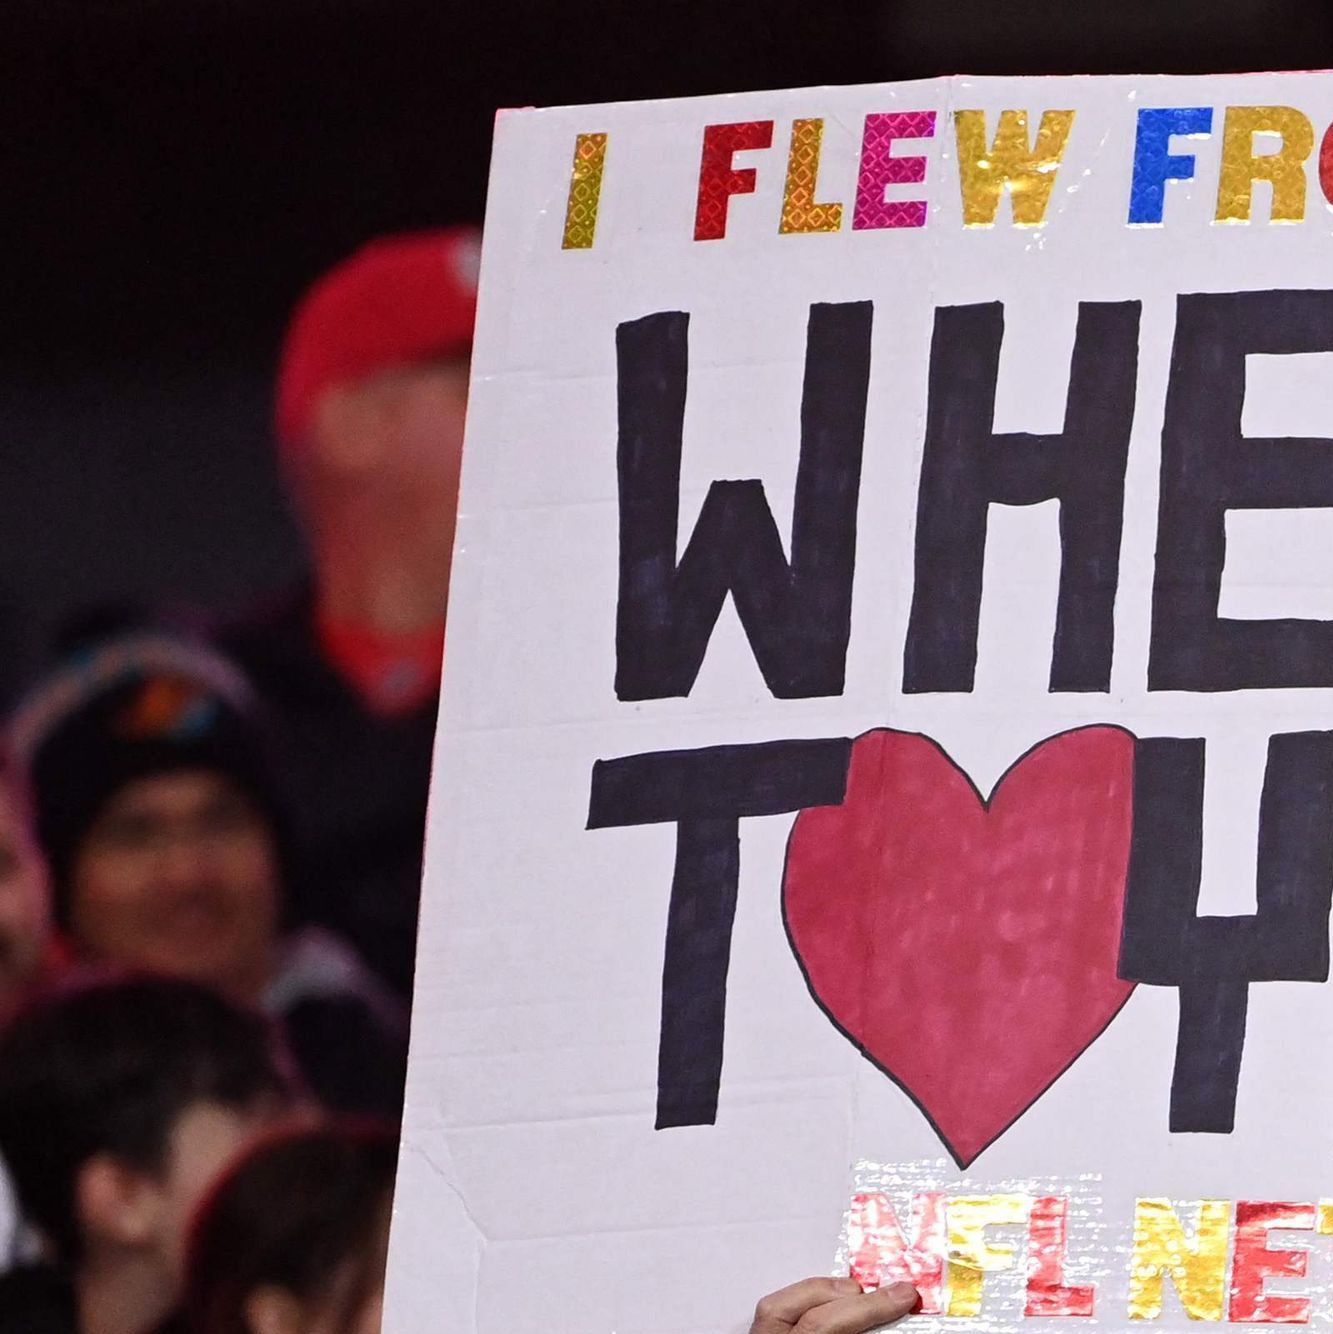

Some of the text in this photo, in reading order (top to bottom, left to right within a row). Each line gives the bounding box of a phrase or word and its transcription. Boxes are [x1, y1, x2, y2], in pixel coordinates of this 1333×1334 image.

[561, 131, 608, 250] I
[693, 108, 1076, 242] FLEW
[848, 1190, 1098, 1318] NFL
